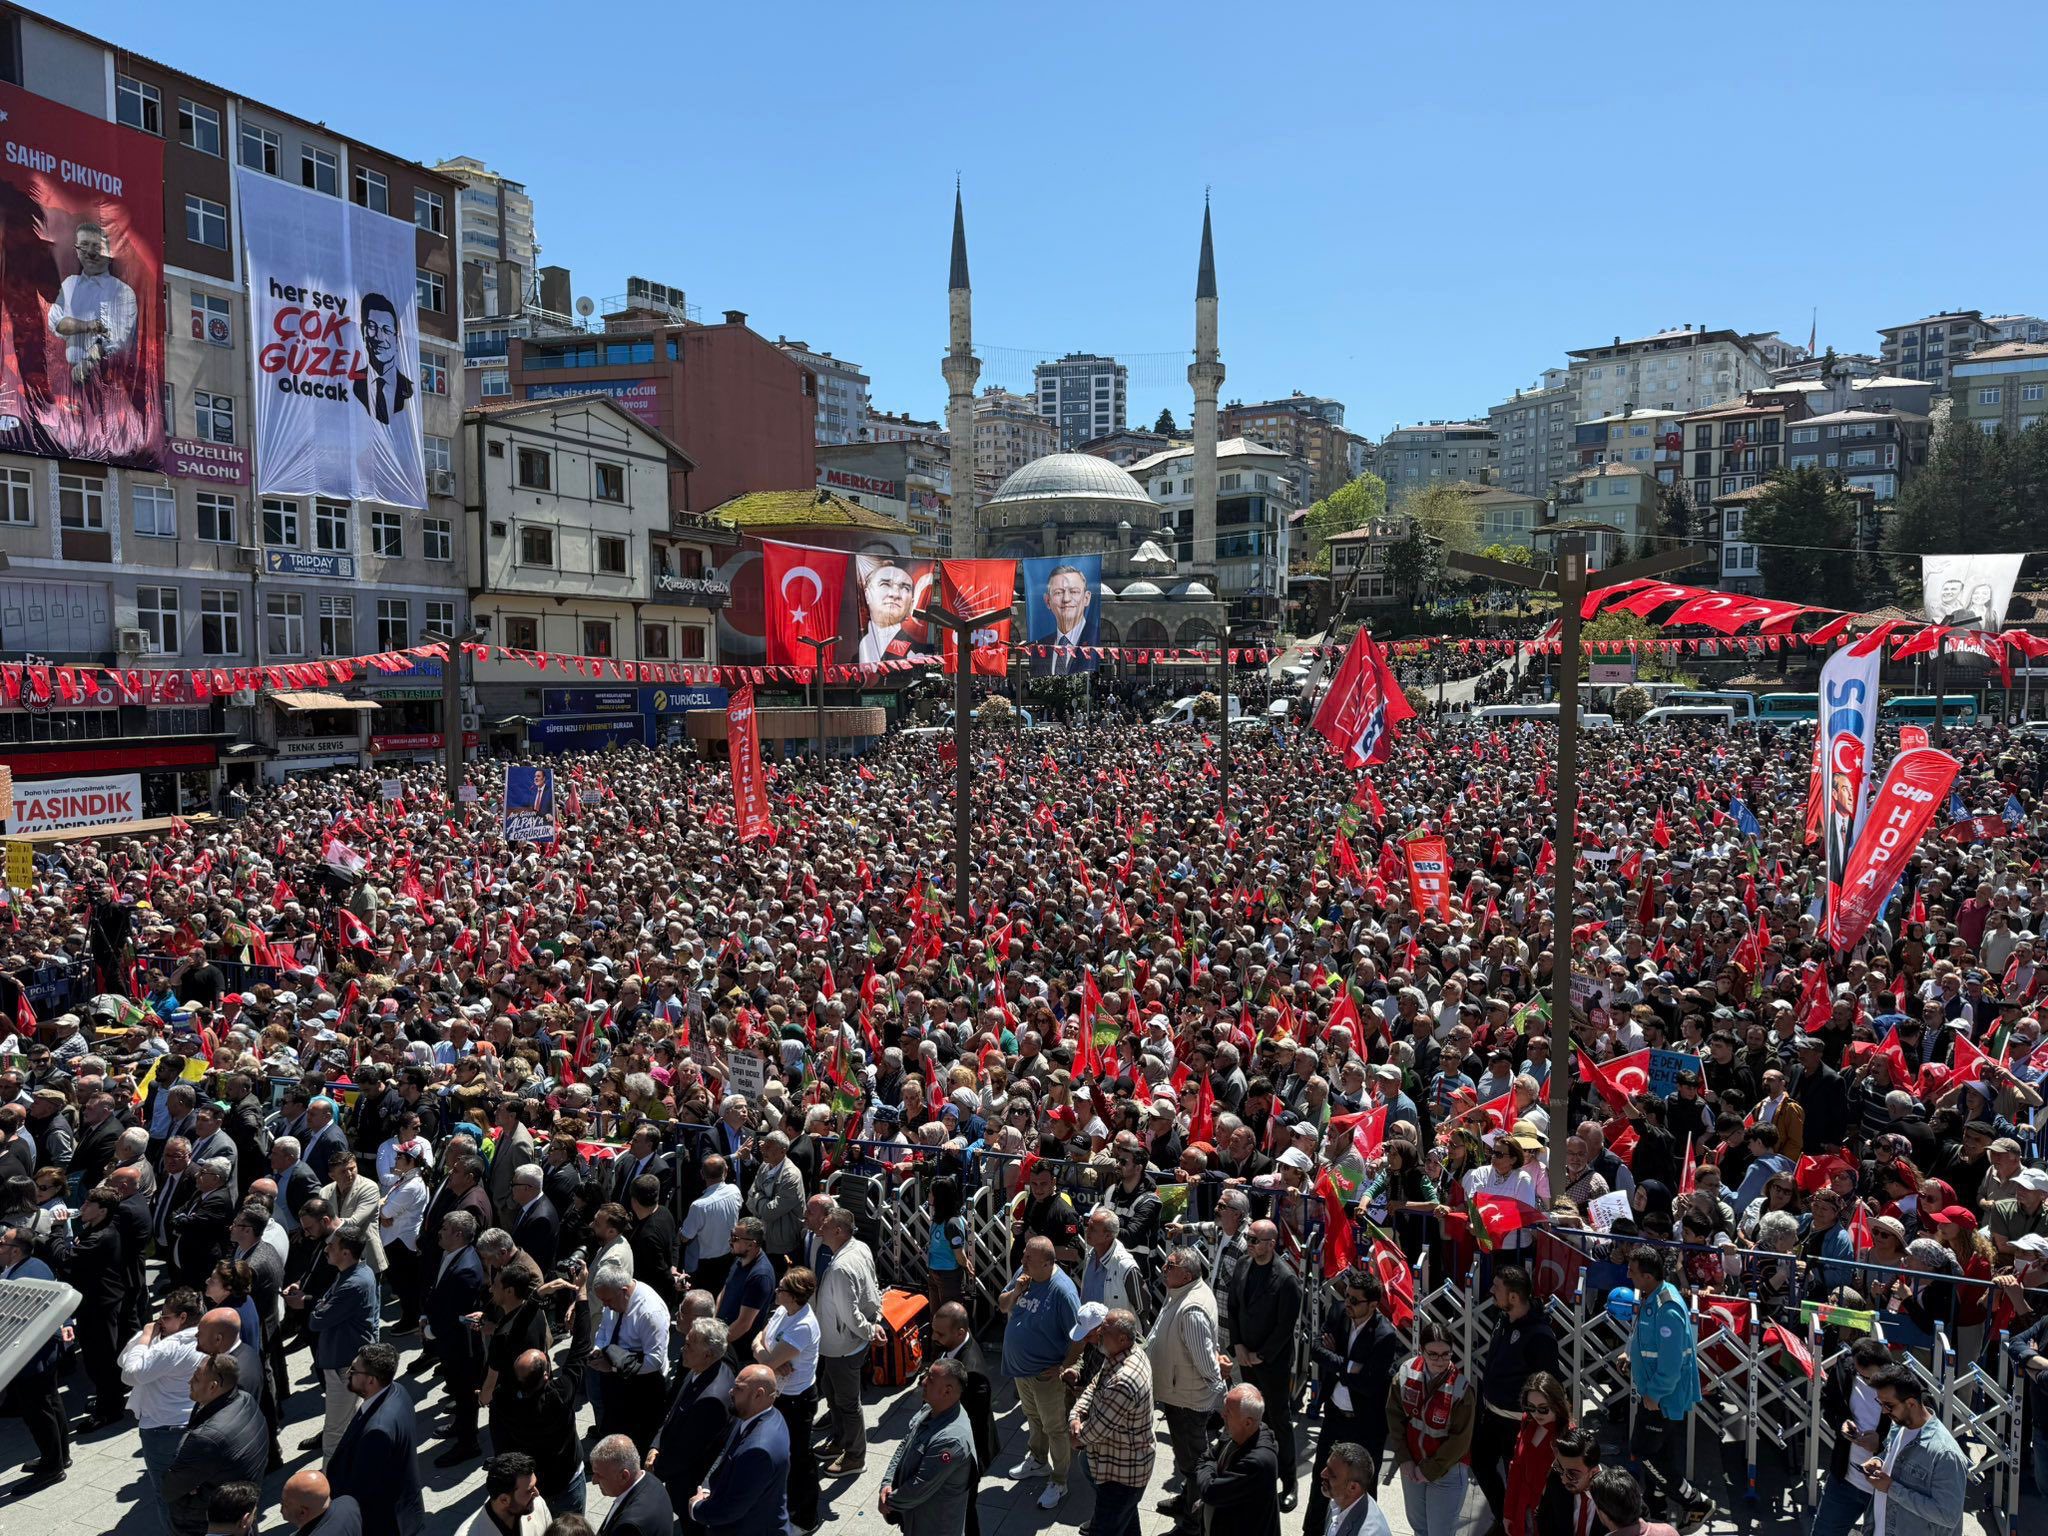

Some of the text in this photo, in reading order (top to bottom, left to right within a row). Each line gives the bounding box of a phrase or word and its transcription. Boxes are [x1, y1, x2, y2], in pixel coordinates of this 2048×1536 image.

[5, 141, 123, 197] SAHİP ÇIKIYOR
[269, 276, 348, 316] her şey
[273, 306, 351, 347] ÇOK
[259, 338, 368, 381] GÜZEL
[278, 374, 349, 403] olacak
[626, 386, 657, 399] ÇOCUK
[171, 440, 244, 464] GÜZELLİK
[177, 460, 241, 480] SALONU
[826, 469, 896, 495] MERKEZİ
[289, 553, 334, 569] TRIPDAY
[669, 693, 711, 706] TURKCELL
[546, 723, 564, 734] SÜPER
[609, 721, 631, 729] BURADA
[24, 789, 42, 797] Daha
[42, 788, 50, 796] iyi
[51, 787, 70, 795] hizmet
[71, 785, 105, 793] sunabilmek
[1891, 782, 1934, 803] CHP
[12, 790, 133, 823] TAŞINDIK
[1857, 805, 1913, 890] HOPA
